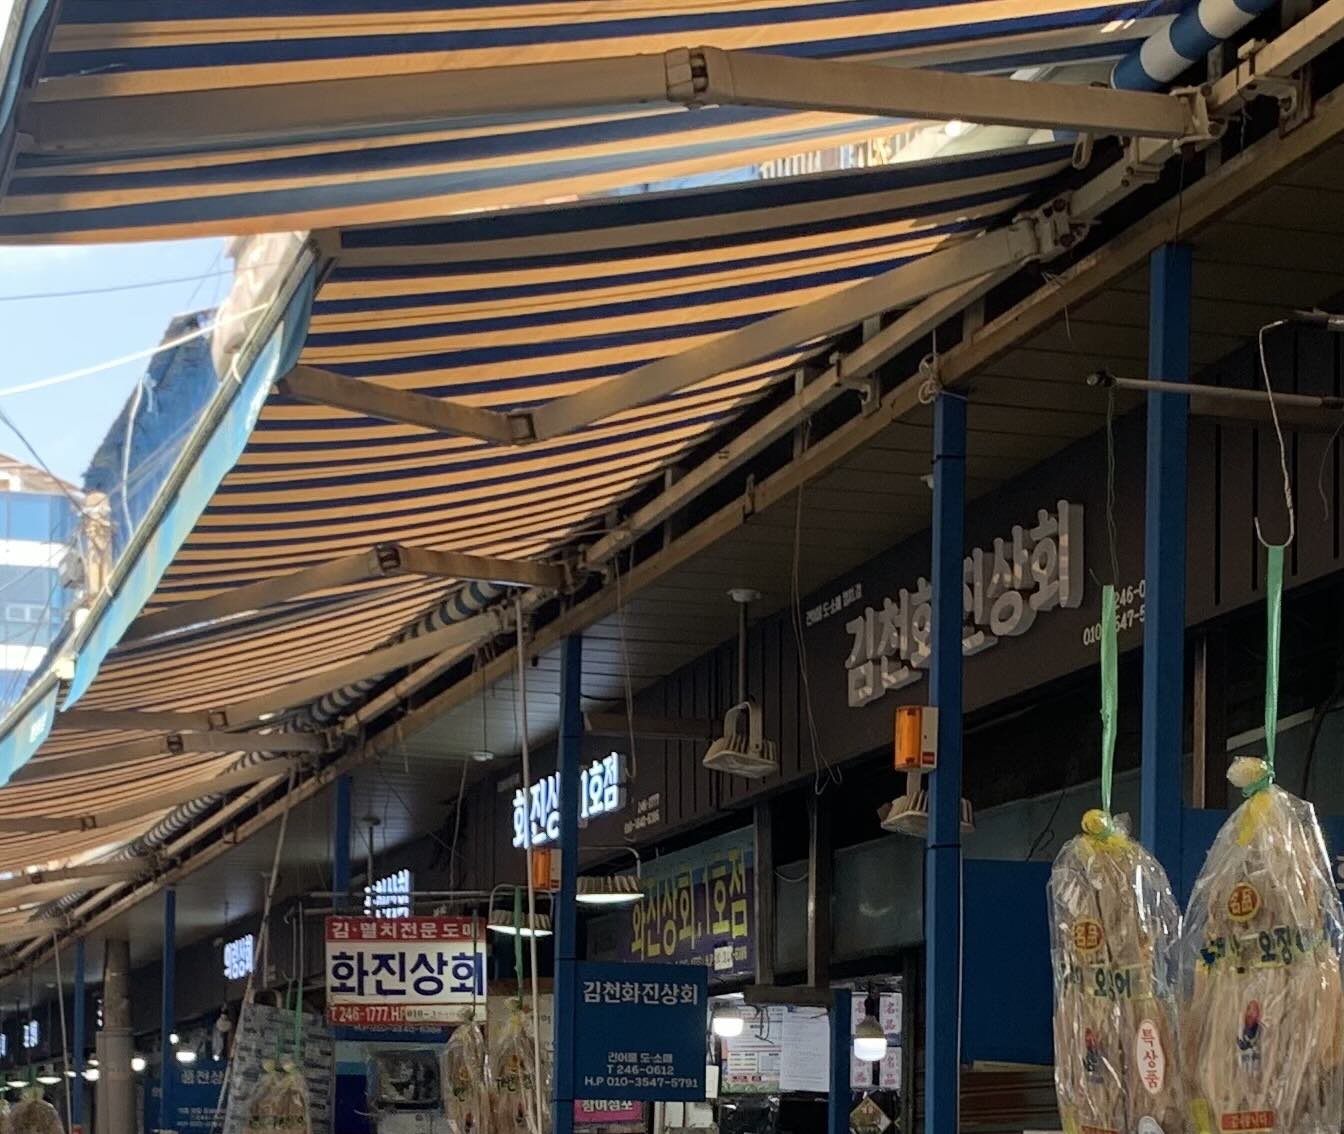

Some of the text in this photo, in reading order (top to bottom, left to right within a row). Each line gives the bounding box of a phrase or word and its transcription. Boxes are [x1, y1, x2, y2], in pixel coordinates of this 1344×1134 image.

[580, 752, 621, 819] 1호점
[330, 951, 485, 997] 화진상회
[582, 981, 699, 1006] 김천화진상회
[1140, 1027, 1160, 1089] 특상품
